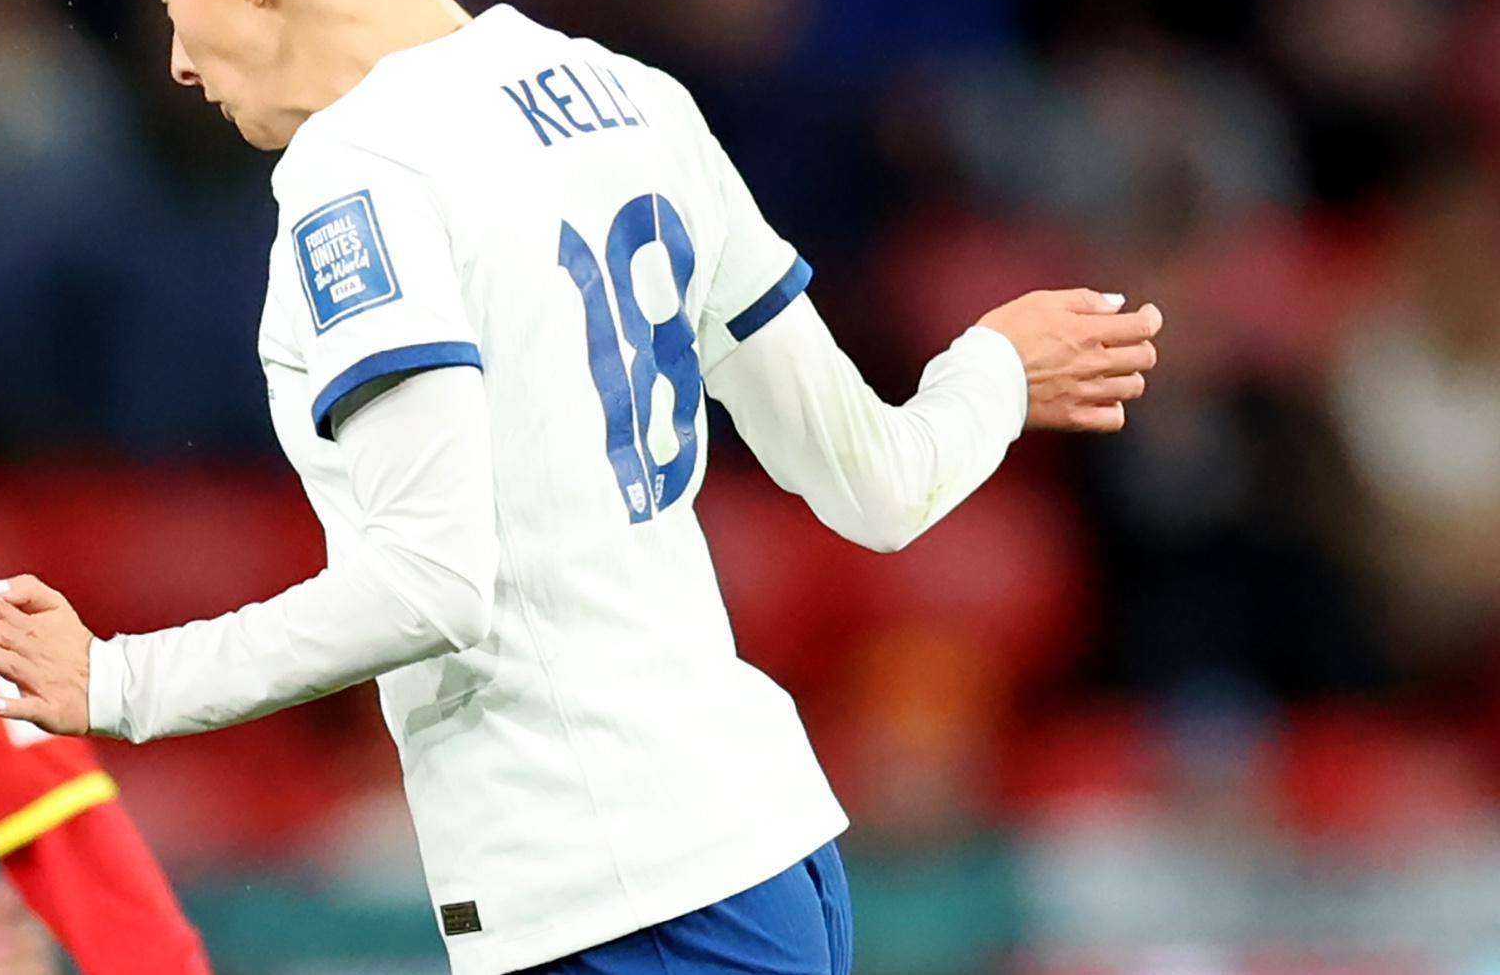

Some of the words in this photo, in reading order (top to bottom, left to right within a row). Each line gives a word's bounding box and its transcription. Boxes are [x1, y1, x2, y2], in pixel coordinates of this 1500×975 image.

[305, 214, 357, 252] FOOTBALL
[310, 230, 363, 271] UNITES
[331, 249, 370, 280] World
[334, 282, 357, 297] FIFA
[557, 193, 702, 525] 18
